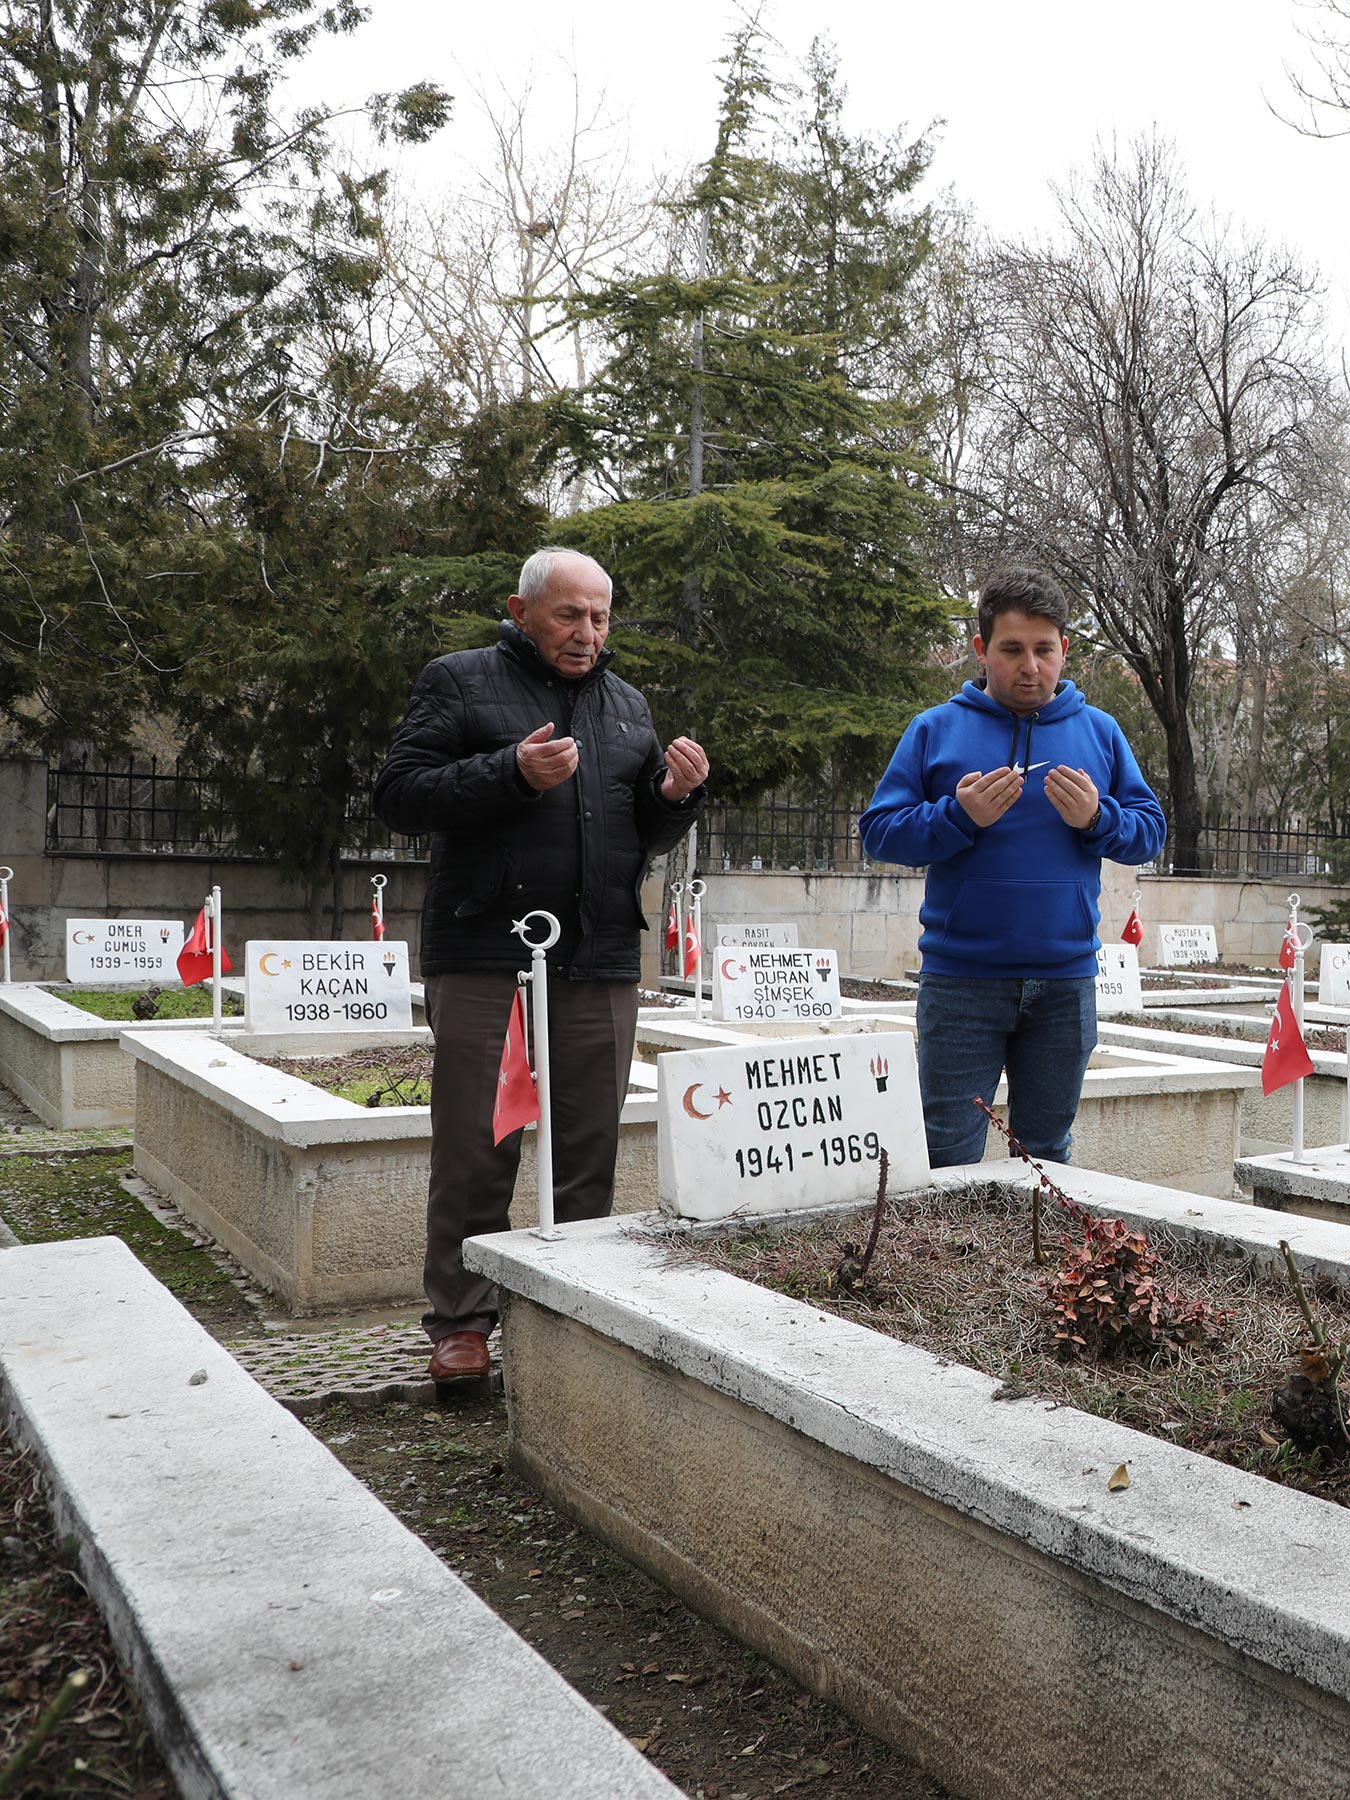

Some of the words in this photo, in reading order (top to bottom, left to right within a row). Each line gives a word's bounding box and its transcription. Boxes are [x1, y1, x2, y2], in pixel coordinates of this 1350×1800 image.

[1174, 928, 1201, 937] MUSTAFA
[301, 950, 366, 971] BEKİR
[749, 953, 813, 968] MEHMET
[754, 970, 810, 985] DURAN
[300, 978, 369, 999] KAÇAN
[753, 985, 815, 1004] ŞİMŞEK
[745, 1053, 842, 1090] MEHMET
[757, 1094, 843, 1131] OZCAN
